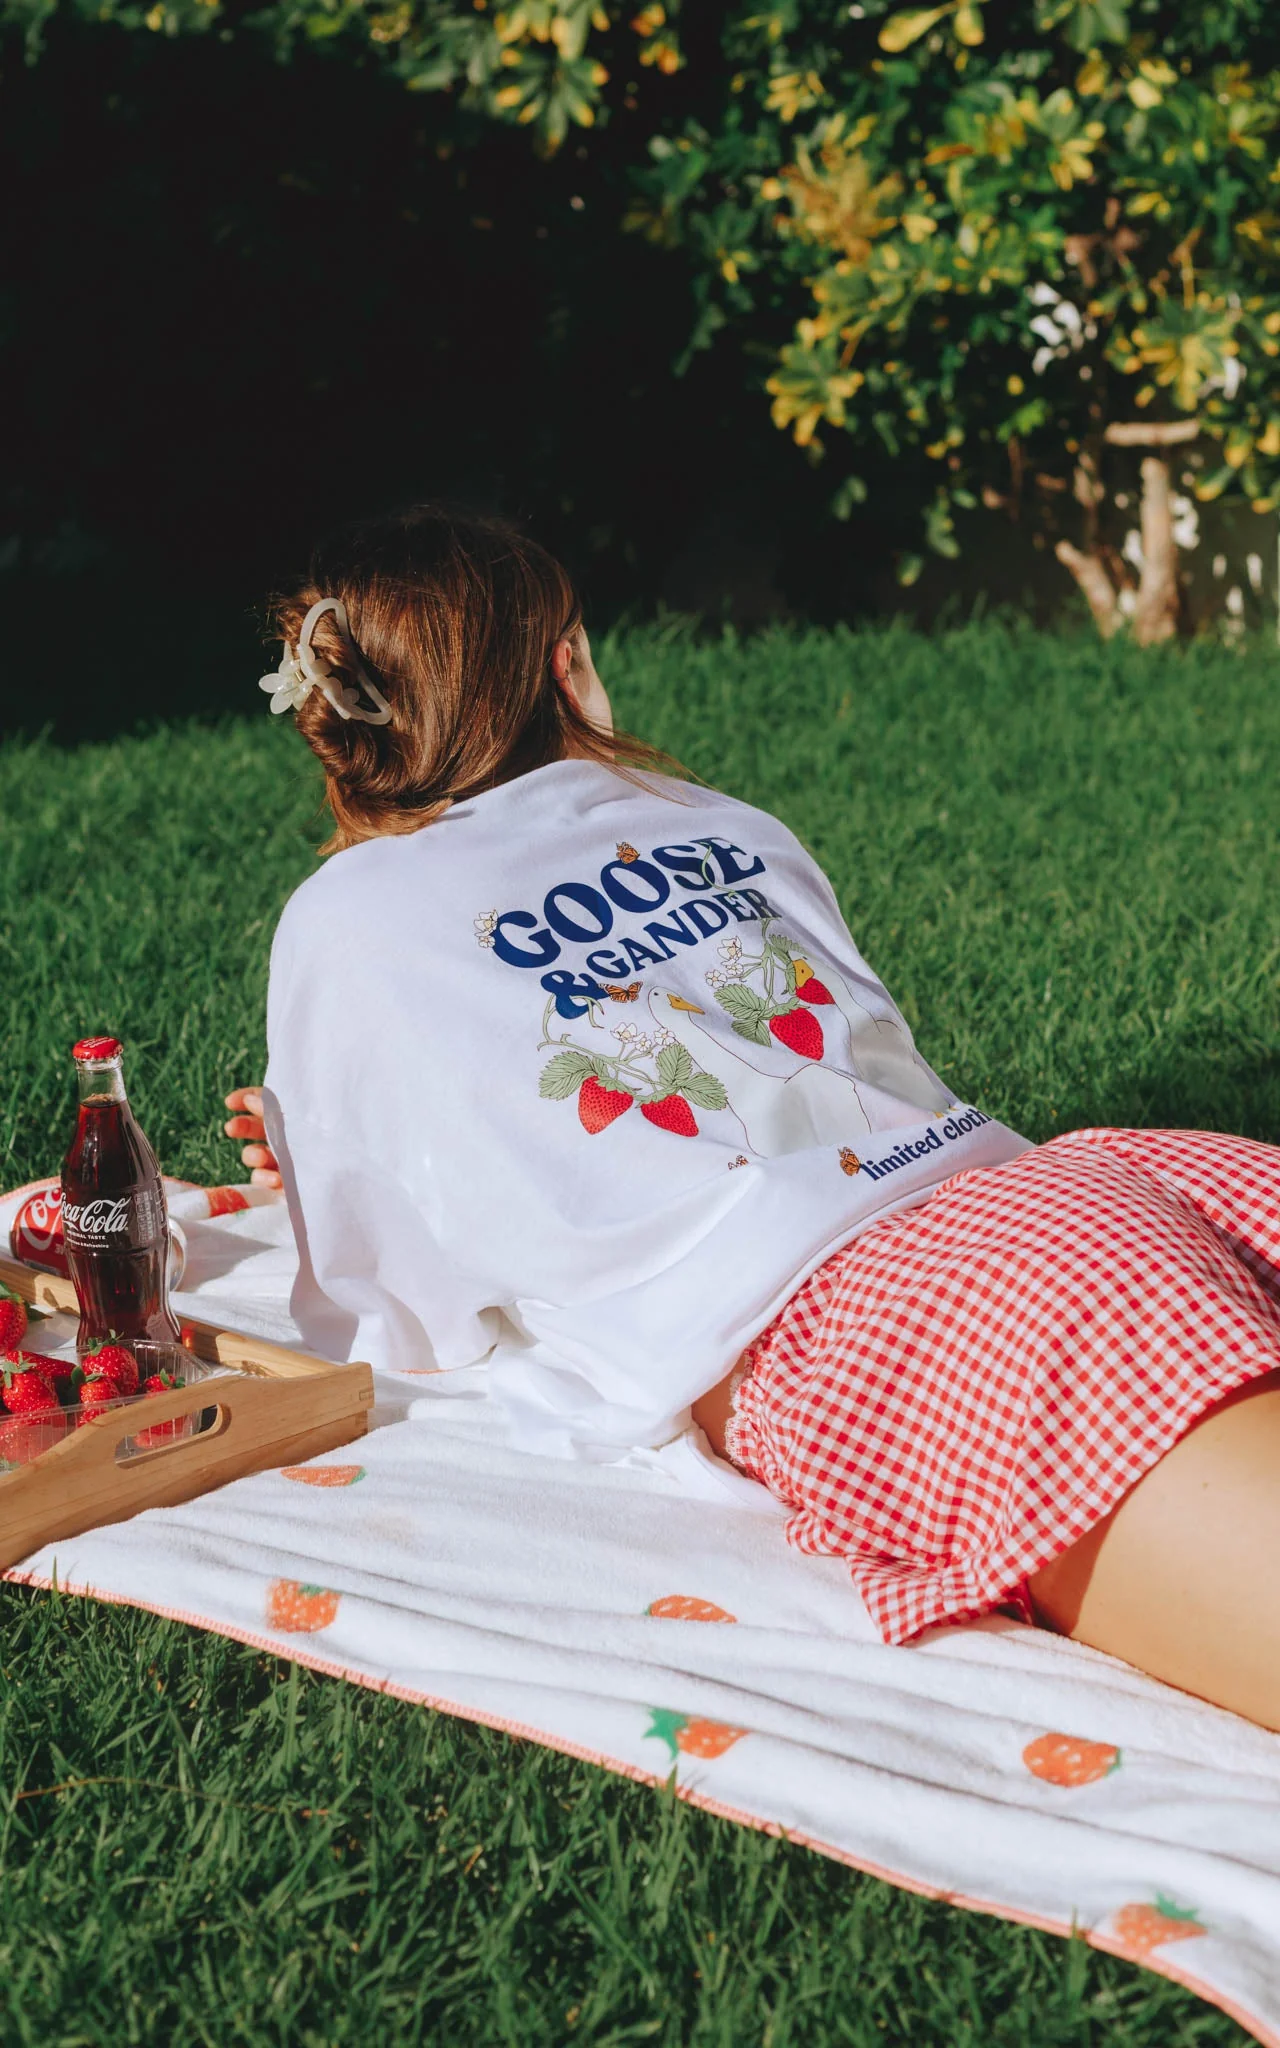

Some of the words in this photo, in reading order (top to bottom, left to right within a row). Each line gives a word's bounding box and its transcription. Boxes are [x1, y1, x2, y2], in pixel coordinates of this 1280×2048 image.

[492, 837, 766, 968] GOOSE
[540, 970, 610, 1019] &
[586, 888, 782, 979] GANDER
[860, 1127, 944, 1181] limited
